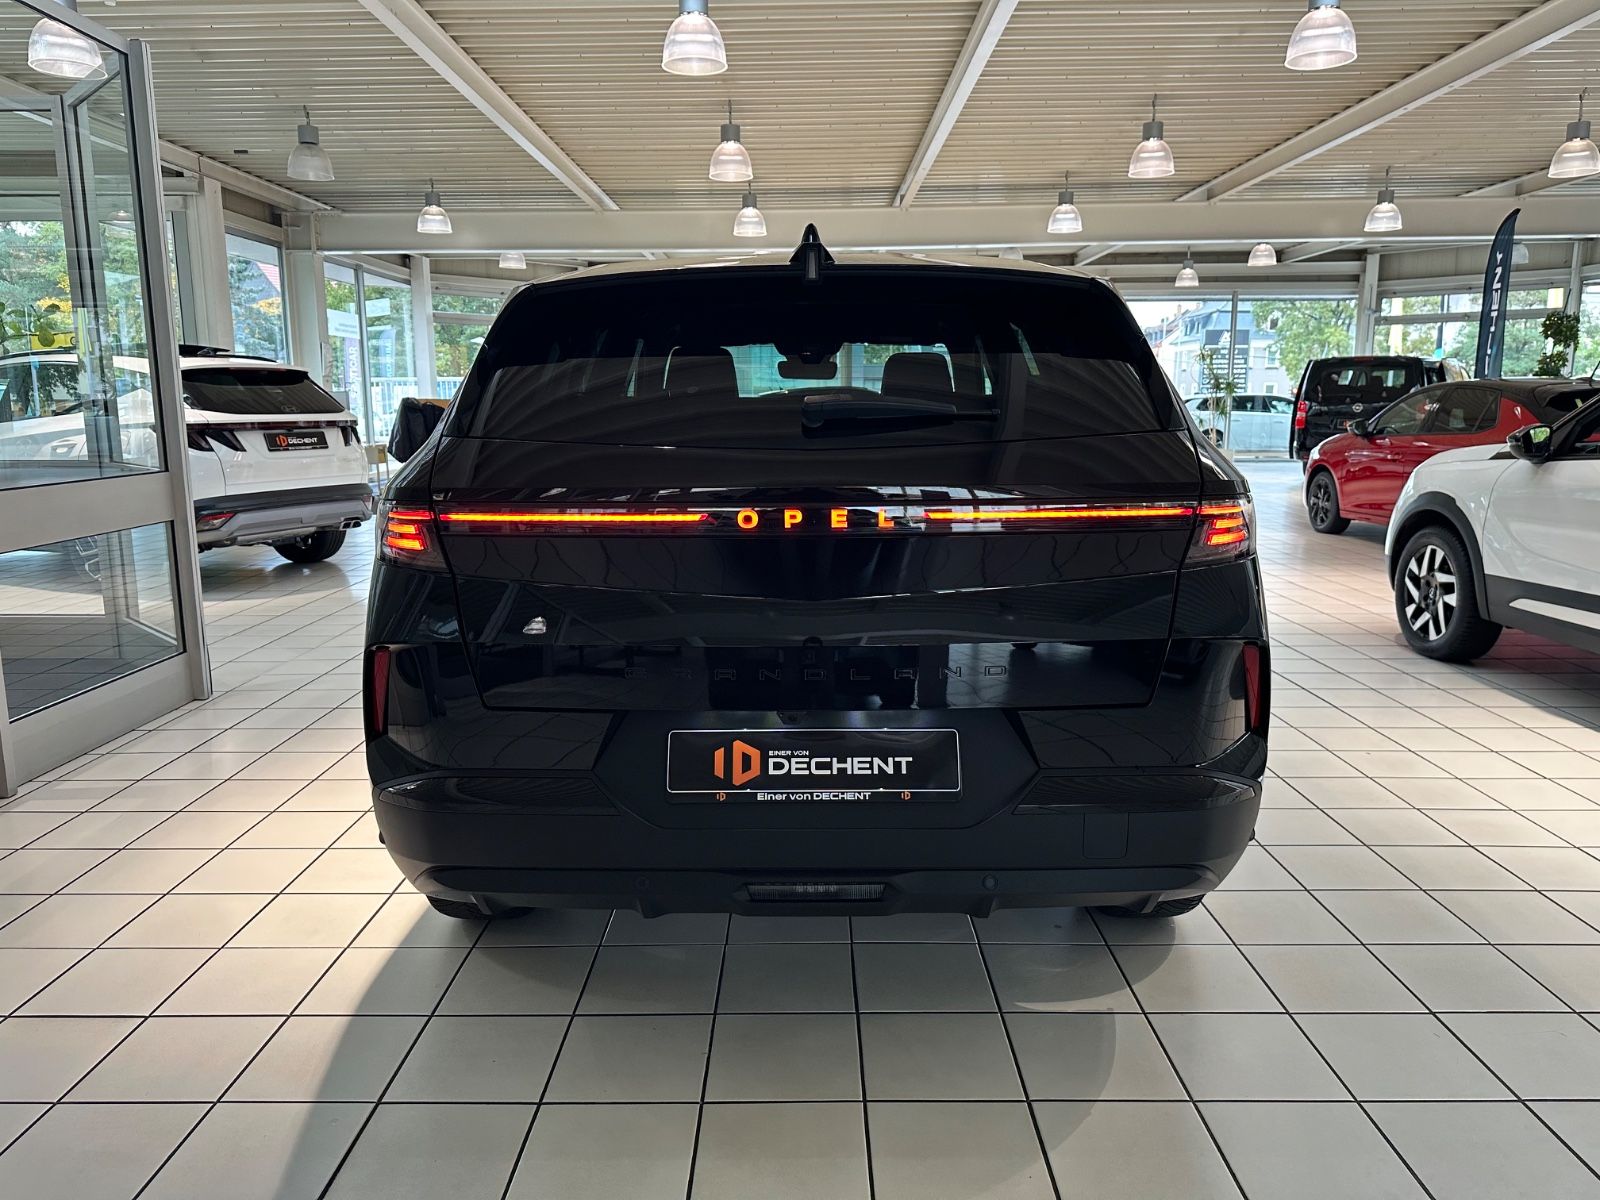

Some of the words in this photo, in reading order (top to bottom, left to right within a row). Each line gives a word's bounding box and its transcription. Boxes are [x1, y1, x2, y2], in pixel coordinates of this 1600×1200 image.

[737, 508, 894, 528] OPEL
[624, 665, 1007, 680] GRANDLAND
[768, 757, 913, 775] DECHENT
[757, 792, 787, 801] Einer
[813, 792, 872, 801] DECHENT
